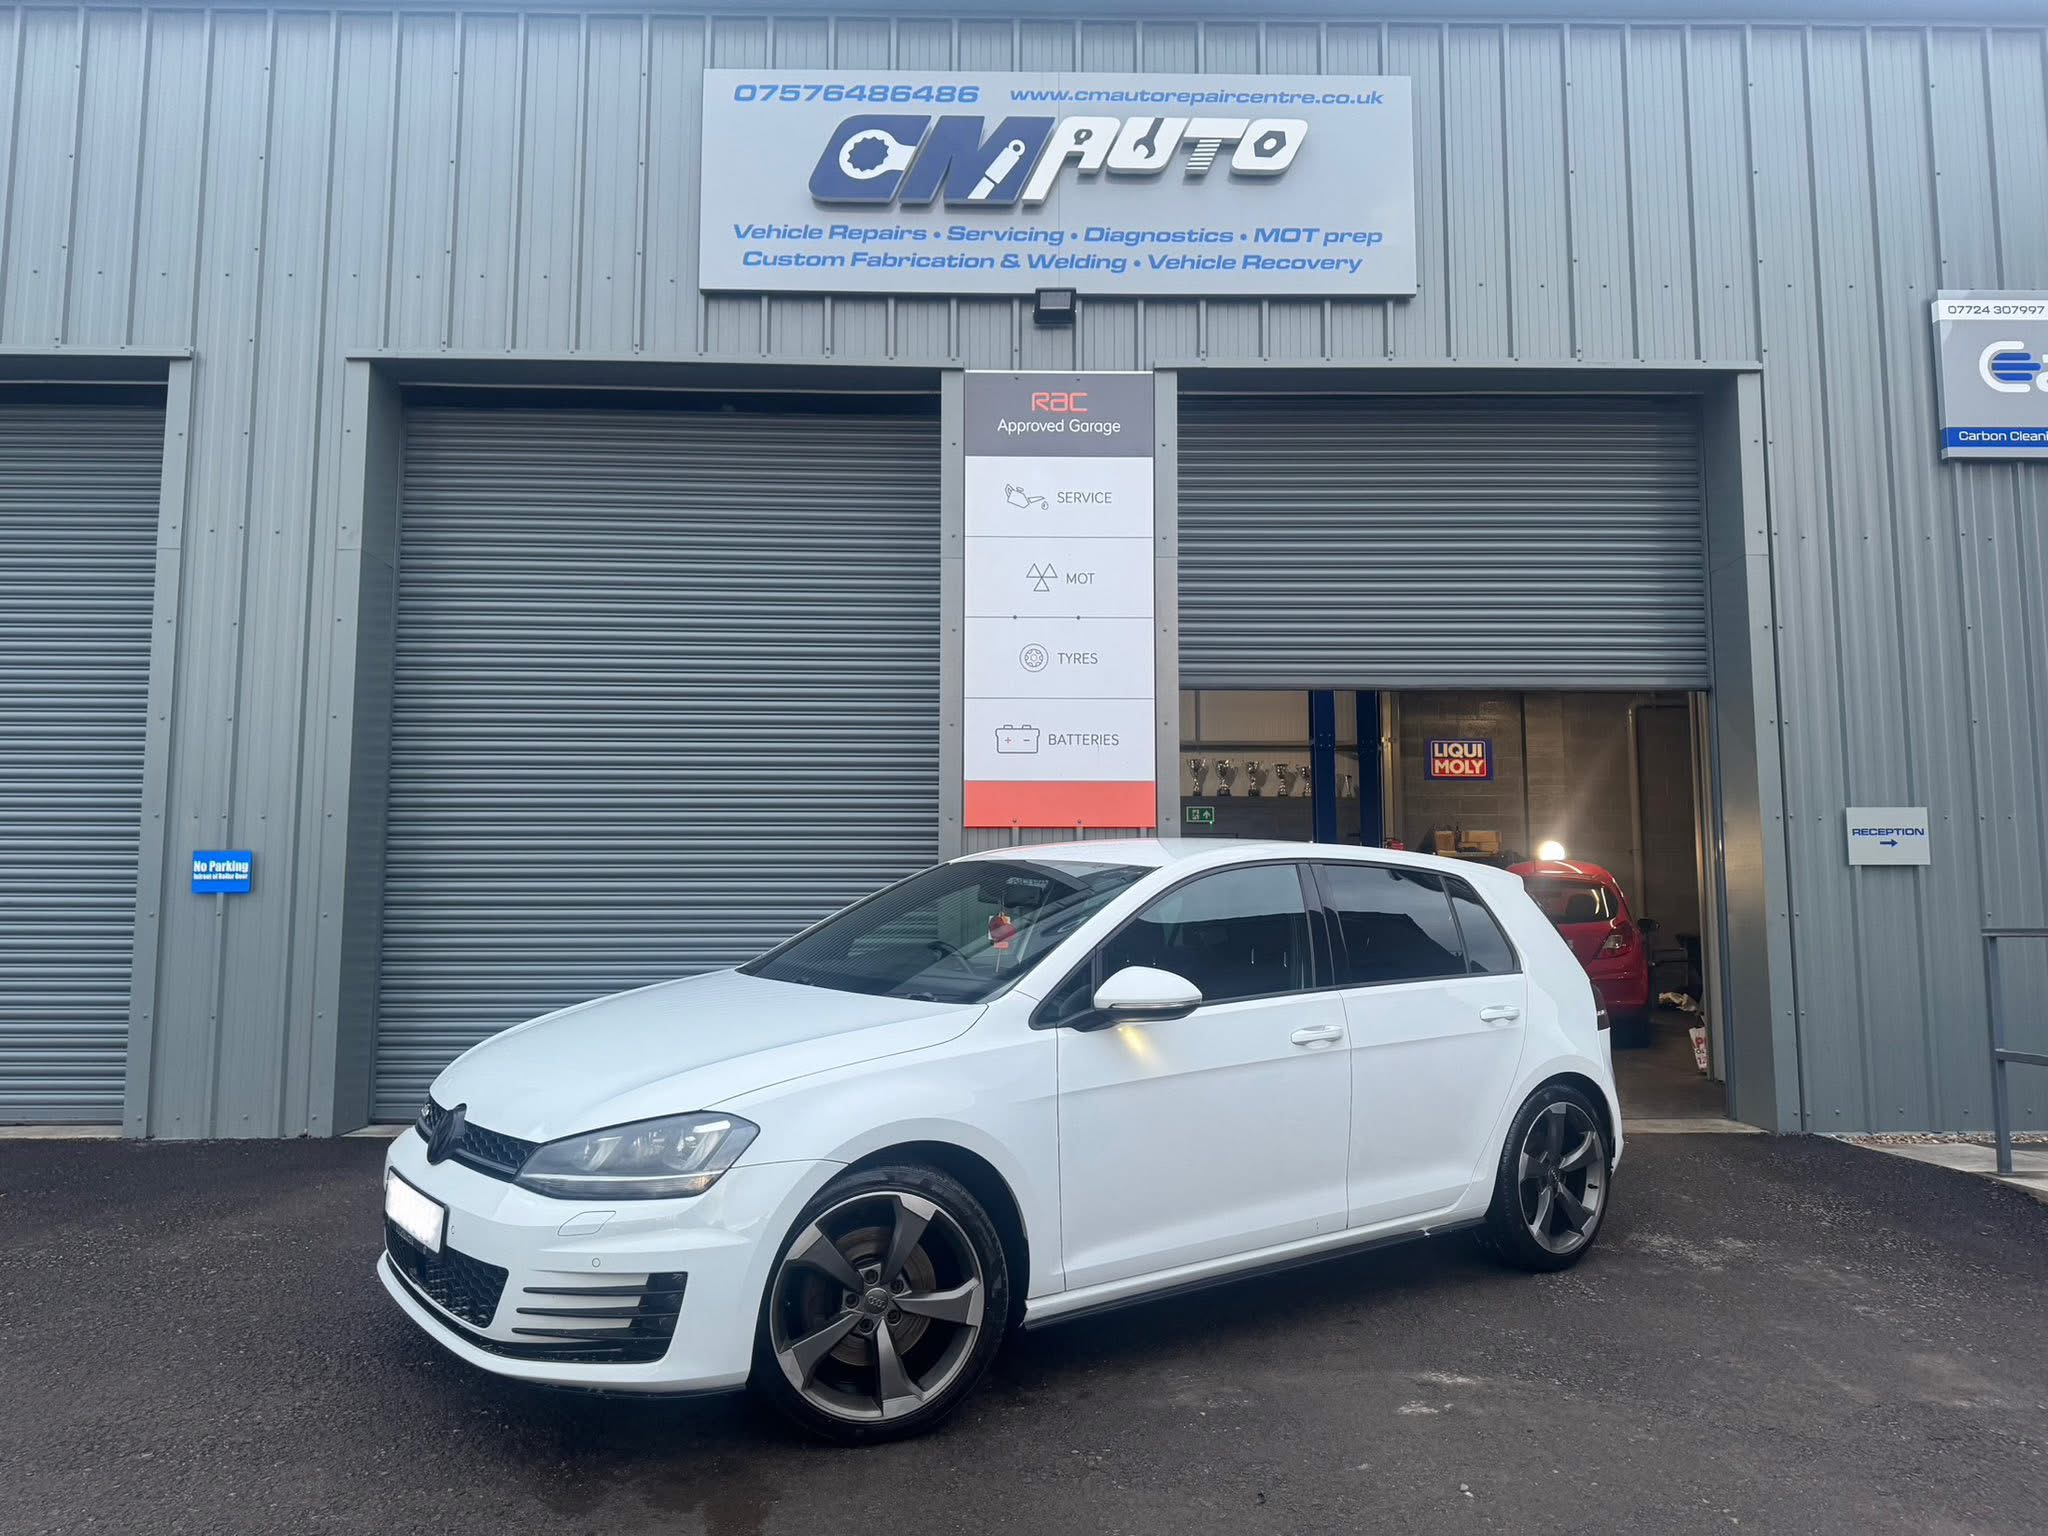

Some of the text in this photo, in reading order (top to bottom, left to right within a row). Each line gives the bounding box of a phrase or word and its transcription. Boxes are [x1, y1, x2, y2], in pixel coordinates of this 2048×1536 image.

[734, 84, 980, 103] 07576486486
[1010, 89, 1385, 106] www.cmautorepaircentre.co.uk
[733, 224, 1384, 247] Vehicle Repairs Servicing Diagnostics MOT prep
[742, 251, 1363, 274] Custom Fabrication & Welding Vehicle Recovery
[1947, 305, 2045, 315] 07724 307997
[997, 418, 1121, 436] Approved Garage
[1958, 430, 2007, 441] Carbon
[1056, 491, 1113, 505] SERVICE
[1066, 572, 1095, 585] MOT
[1057, 652, 1099, 665] TYRES
[1047, 733, 1120, 746] BATTERIES
[1433, 743, 1483, 758] LIQUI
[1434, 759, 1484, 774] MOLY
[1851, 827, 1925, 836] RECEPTION
[193, 860, 249, 873] No Parking
